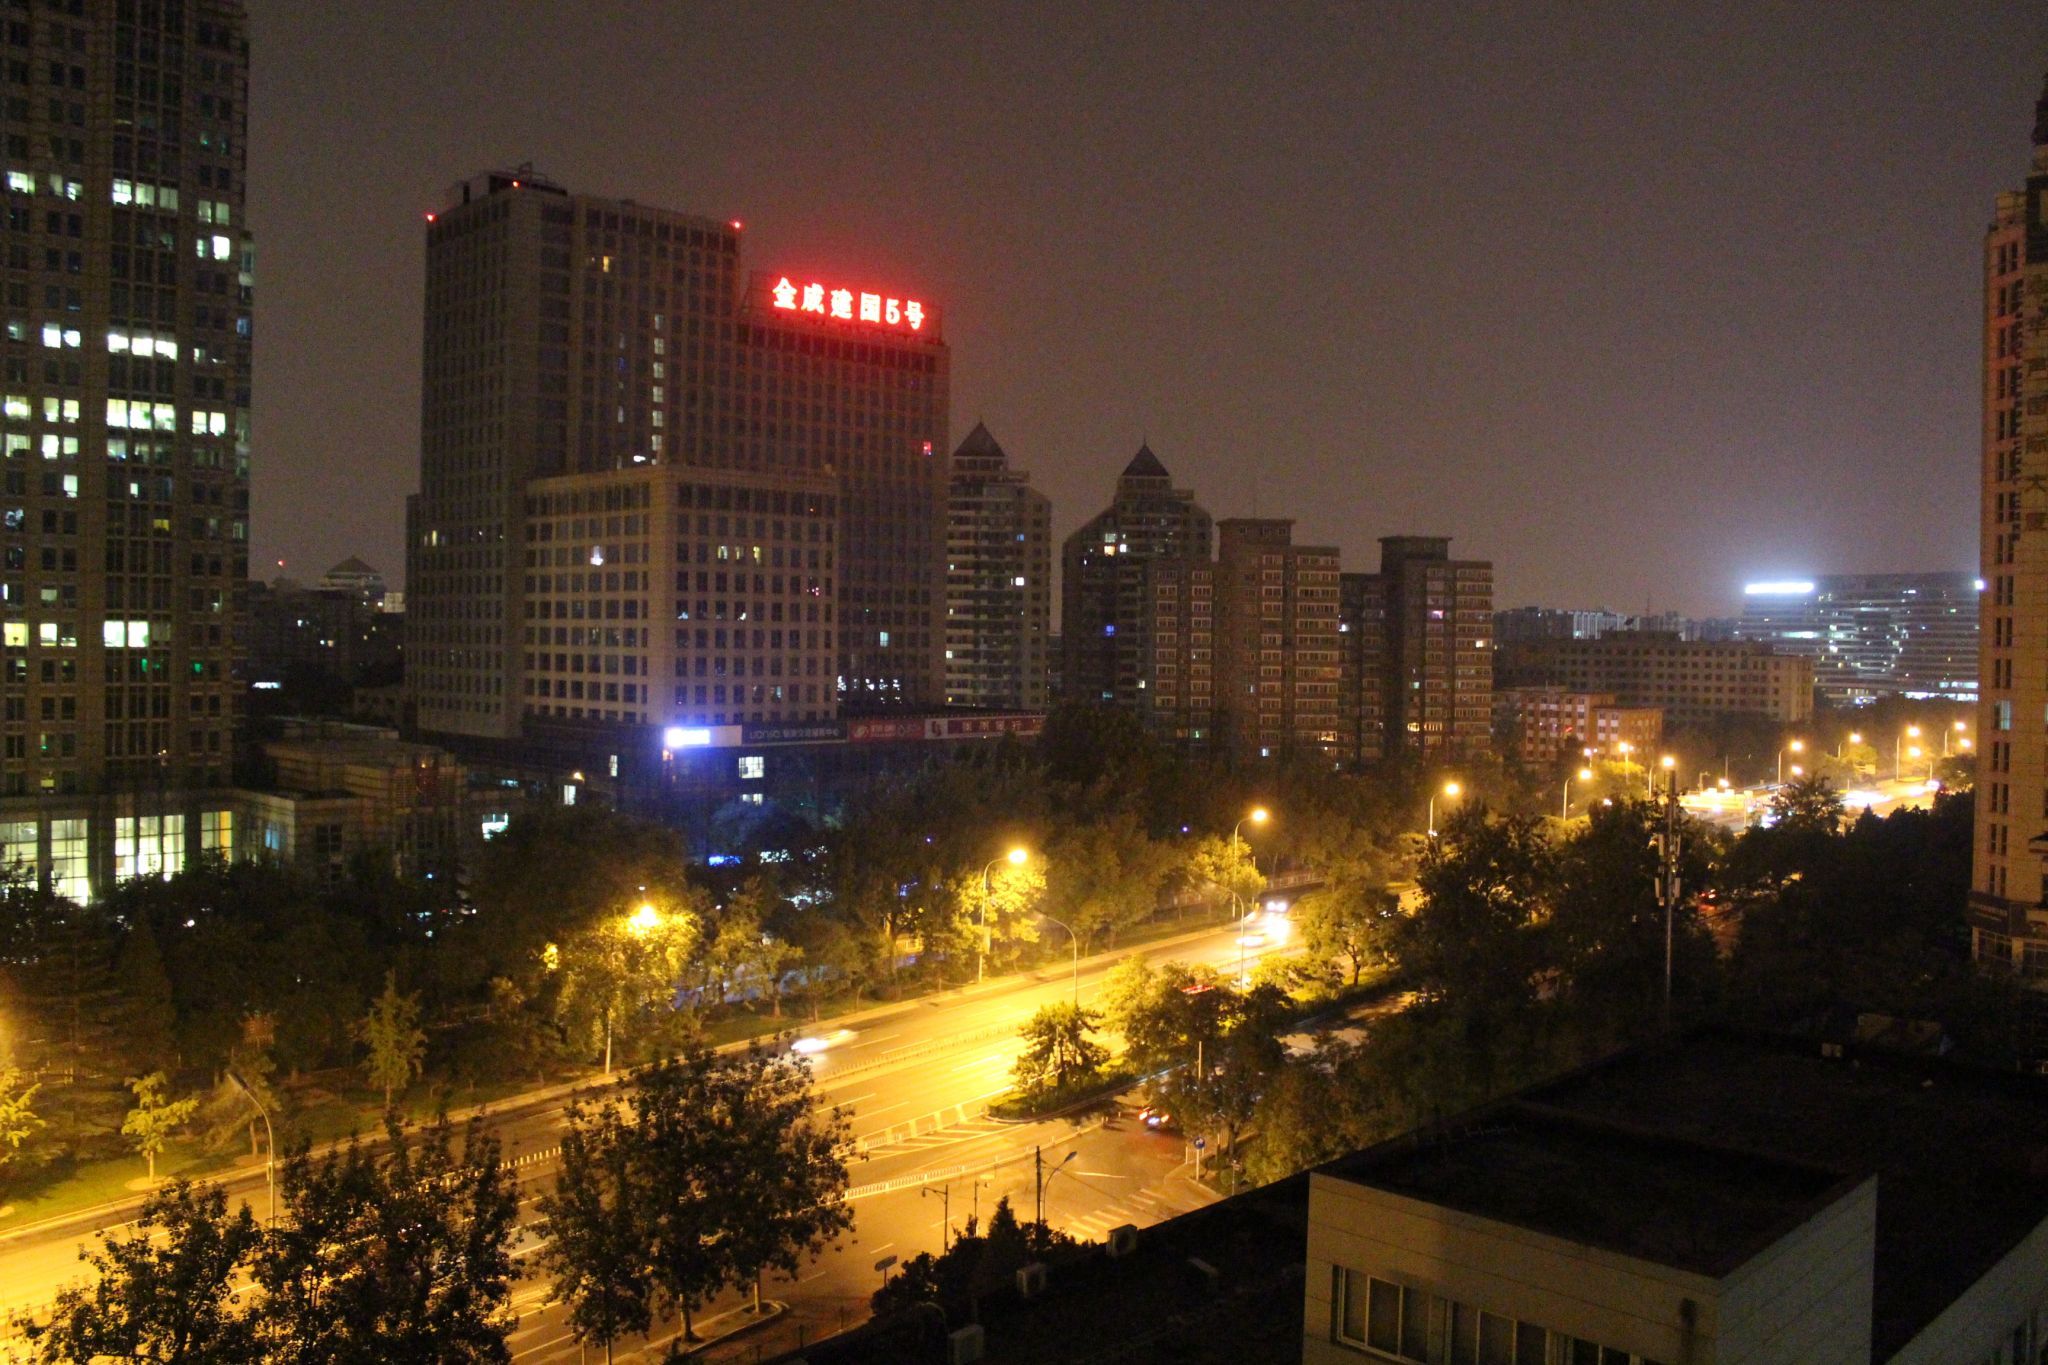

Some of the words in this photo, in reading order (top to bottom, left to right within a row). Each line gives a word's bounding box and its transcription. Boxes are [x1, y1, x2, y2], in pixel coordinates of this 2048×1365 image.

[772, 277, 925, 330] 金成建国5号
